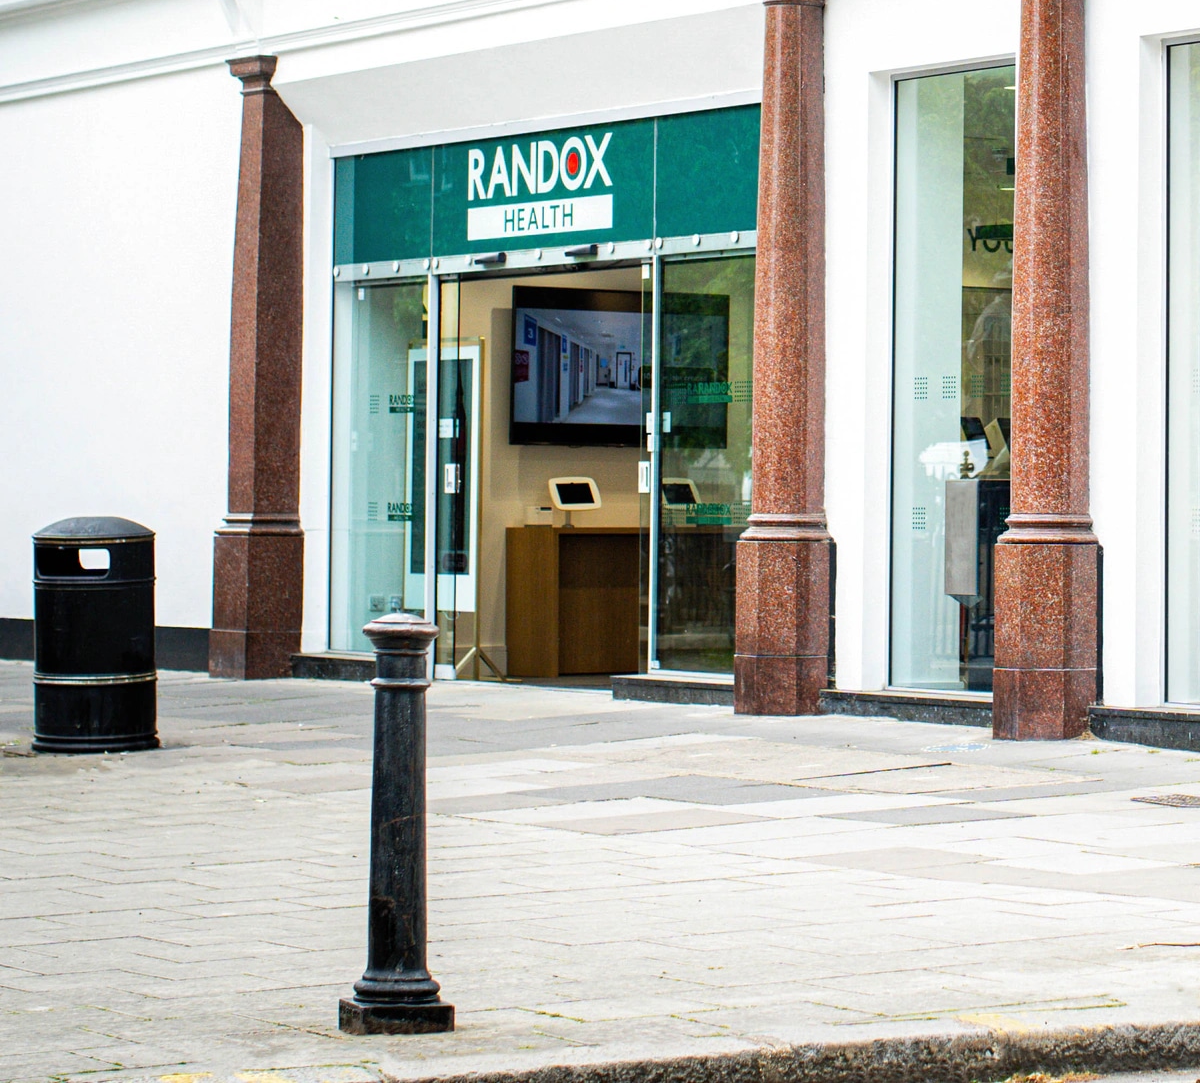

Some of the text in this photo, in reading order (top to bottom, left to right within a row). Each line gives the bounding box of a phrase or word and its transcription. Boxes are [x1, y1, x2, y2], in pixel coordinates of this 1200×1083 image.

[467, 132, 613, 201] RANDOX
[504, 203, 574, 232] HEALTH
[527, 328, 534, 339] 3
